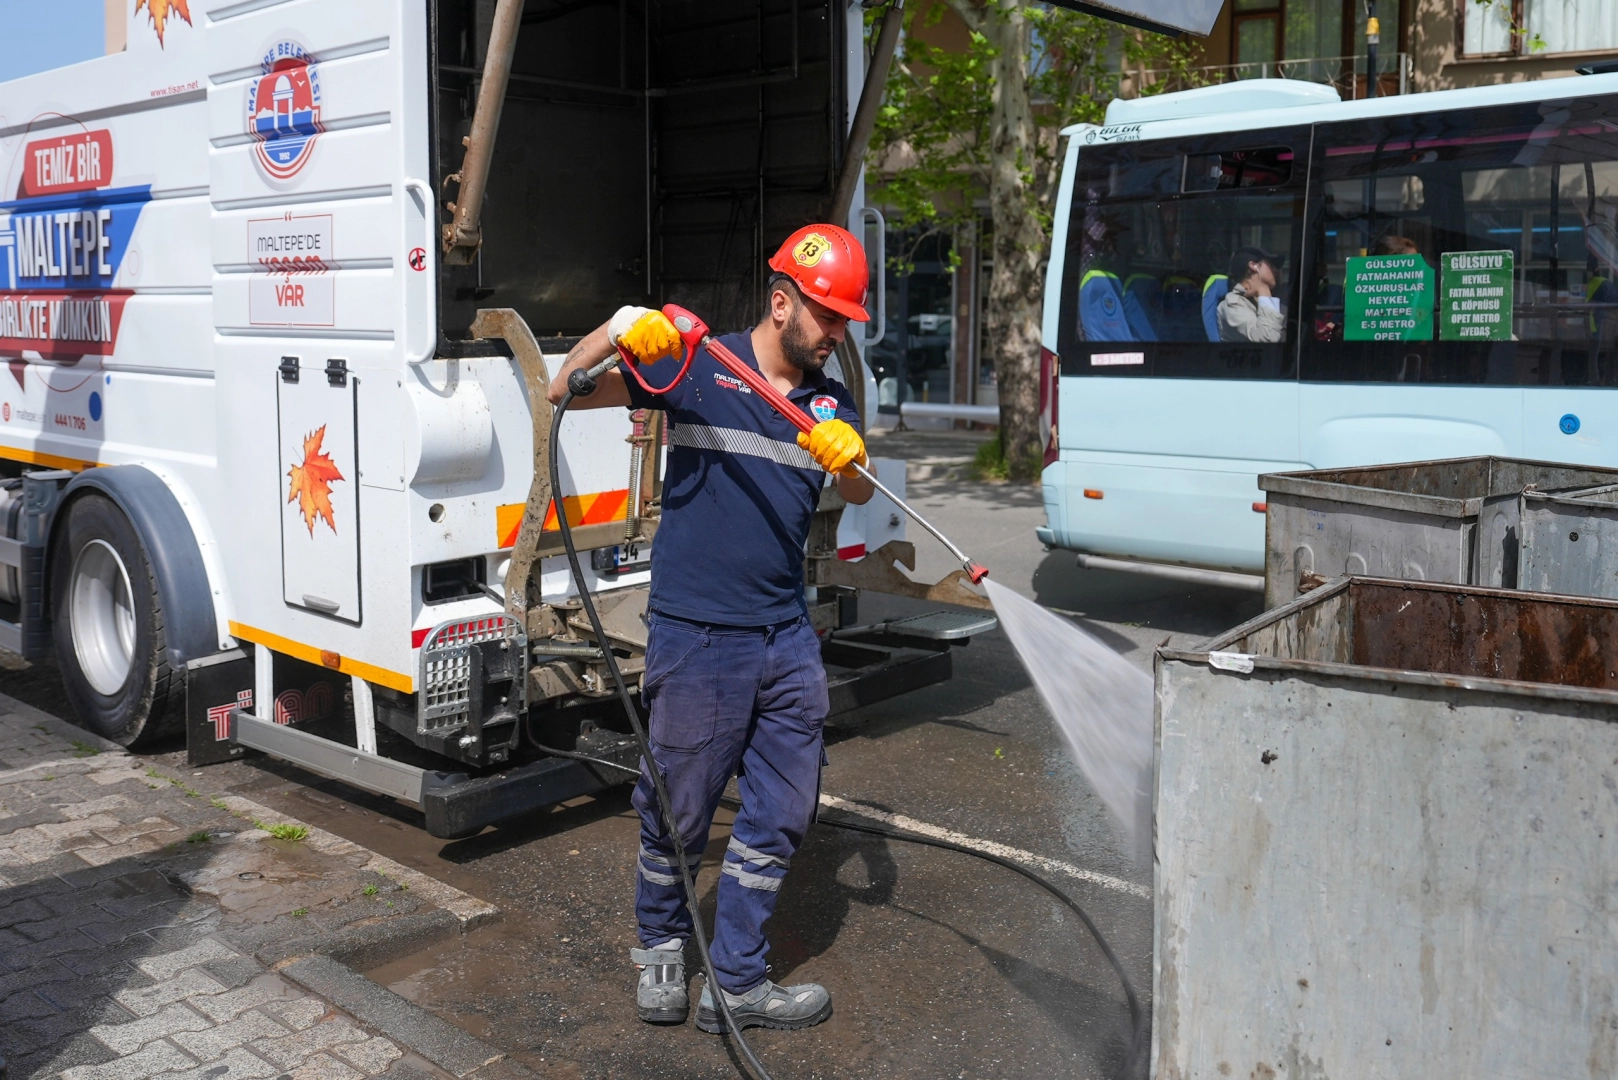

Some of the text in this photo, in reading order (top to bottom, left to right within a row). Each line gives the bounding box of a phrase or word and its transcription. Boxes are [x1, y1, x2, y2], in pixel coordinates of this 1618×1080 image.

[150, 80, 198, 97] www.tisan.net
[35, 135, 101, 187] TEMİZ BİR
[279, 152, 290, 160] 1992
[15, 208, 112, 277] MALTEPE
[802, 241, 820, 257] 13
[1365, 259, 1415, 270] GÜLSUYU
[1451, 255, 1503, 269] GÜLSUYU
[1356, 271, 1424, 282] FATMAHANIM
[1462, 274, 1491, 284] HEYKEL
[1355, 283, 1424, 294] ÖZKURUŞLAR
[1449, 287, 1504, 298] FATMA HANIM
[275, 284, 305, 307] VAR
[1368, 296, 1409, 305] HEYKEL
[1452, 299, 1500, 311] G. KÖPRÜSÜ
[1365, 308, 1412, 317] MALTEPE
[49, 295, 112, 342] MÜMKÜN
[1451, 313, 1500, 324] OPET METRO
[1361, 320, 1416, 329] E-5 METRO
[1374, 332, 1401, 341] OPET
[1460, 326, 1490, 337] AYEDAŞ
[738, 384, 752, 394] VAR
